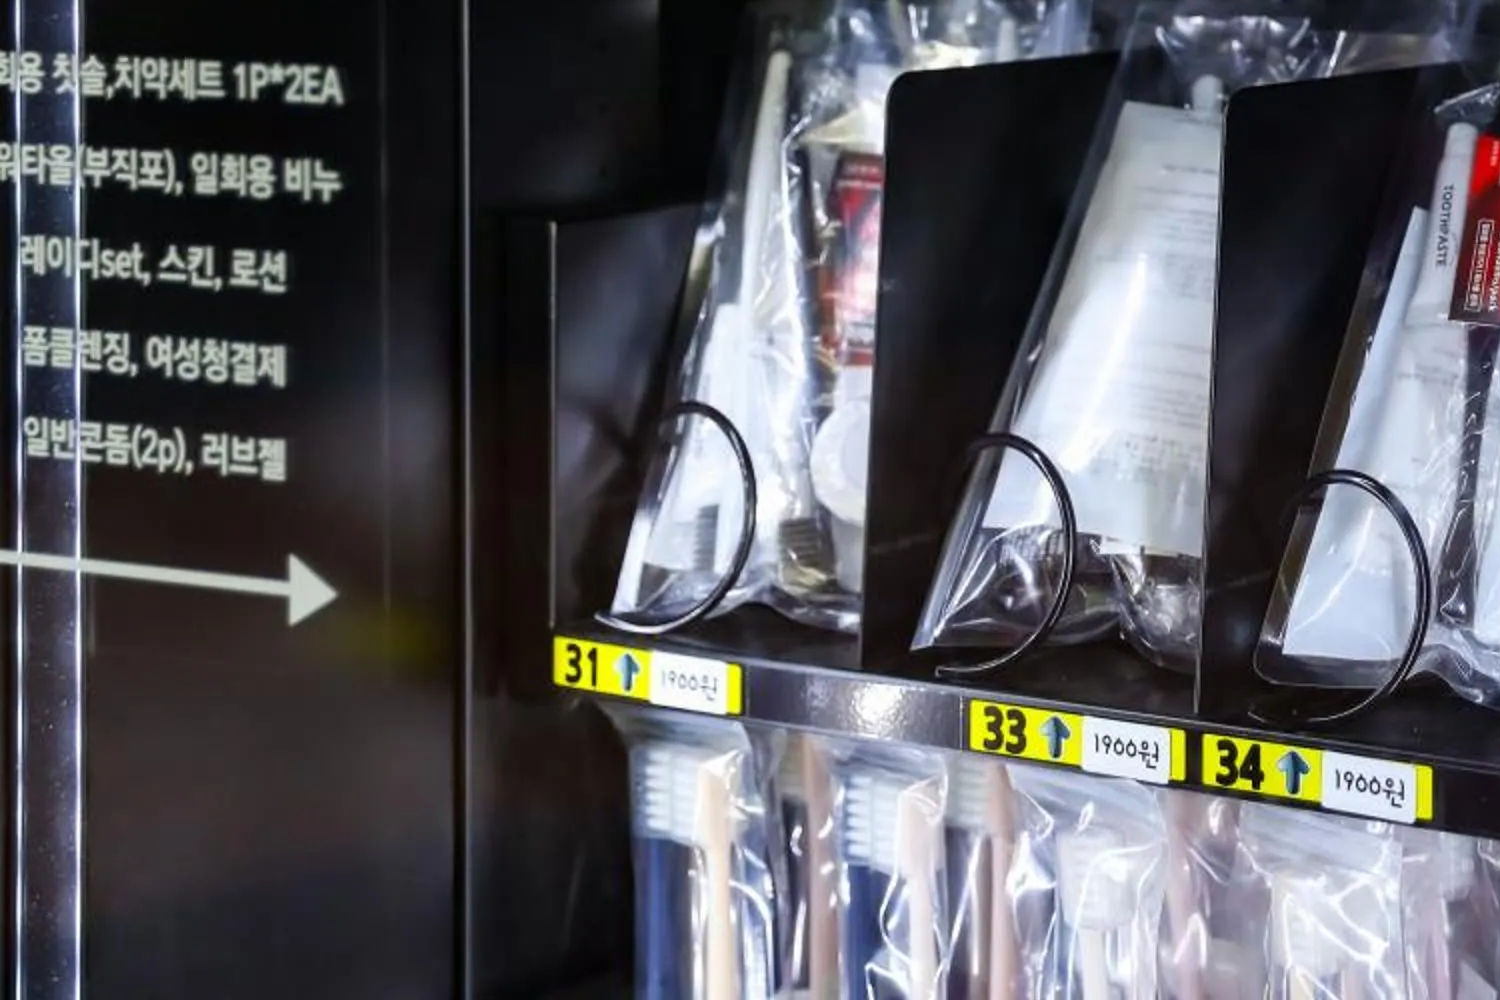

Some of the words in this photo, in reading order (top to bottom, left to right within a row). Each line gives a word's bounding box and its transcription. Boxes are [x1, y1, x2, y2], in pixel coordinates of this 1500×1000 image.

[191, 153, 276, 199] 일회용
[284, 158, 342, 202] 비누
[1435, 184, 1455, 267] TOOTHPASTE
[20, 235, 151, 286] 레이디set,
[159, 245, 222, 291] 스킨,
[230, 250, 287, 293] 로션
[22, 325, 138, 377] 폼클렌징,
[147, 336, 287, 388] 여성청결제
[24, 416, 194, 475] 일반콘돔(2p),
[201, 433, 287, 482] 러브젤
[565, 643, 598, 688] 31
[661, 668, 718, 701] 1900원
[983, 706, 1027, 755] 33
[1094, 733, 1159, 770] 1900원
[1215, 739, 1264, 792] 34
[1335, 768, 1405, 808] 1900원
